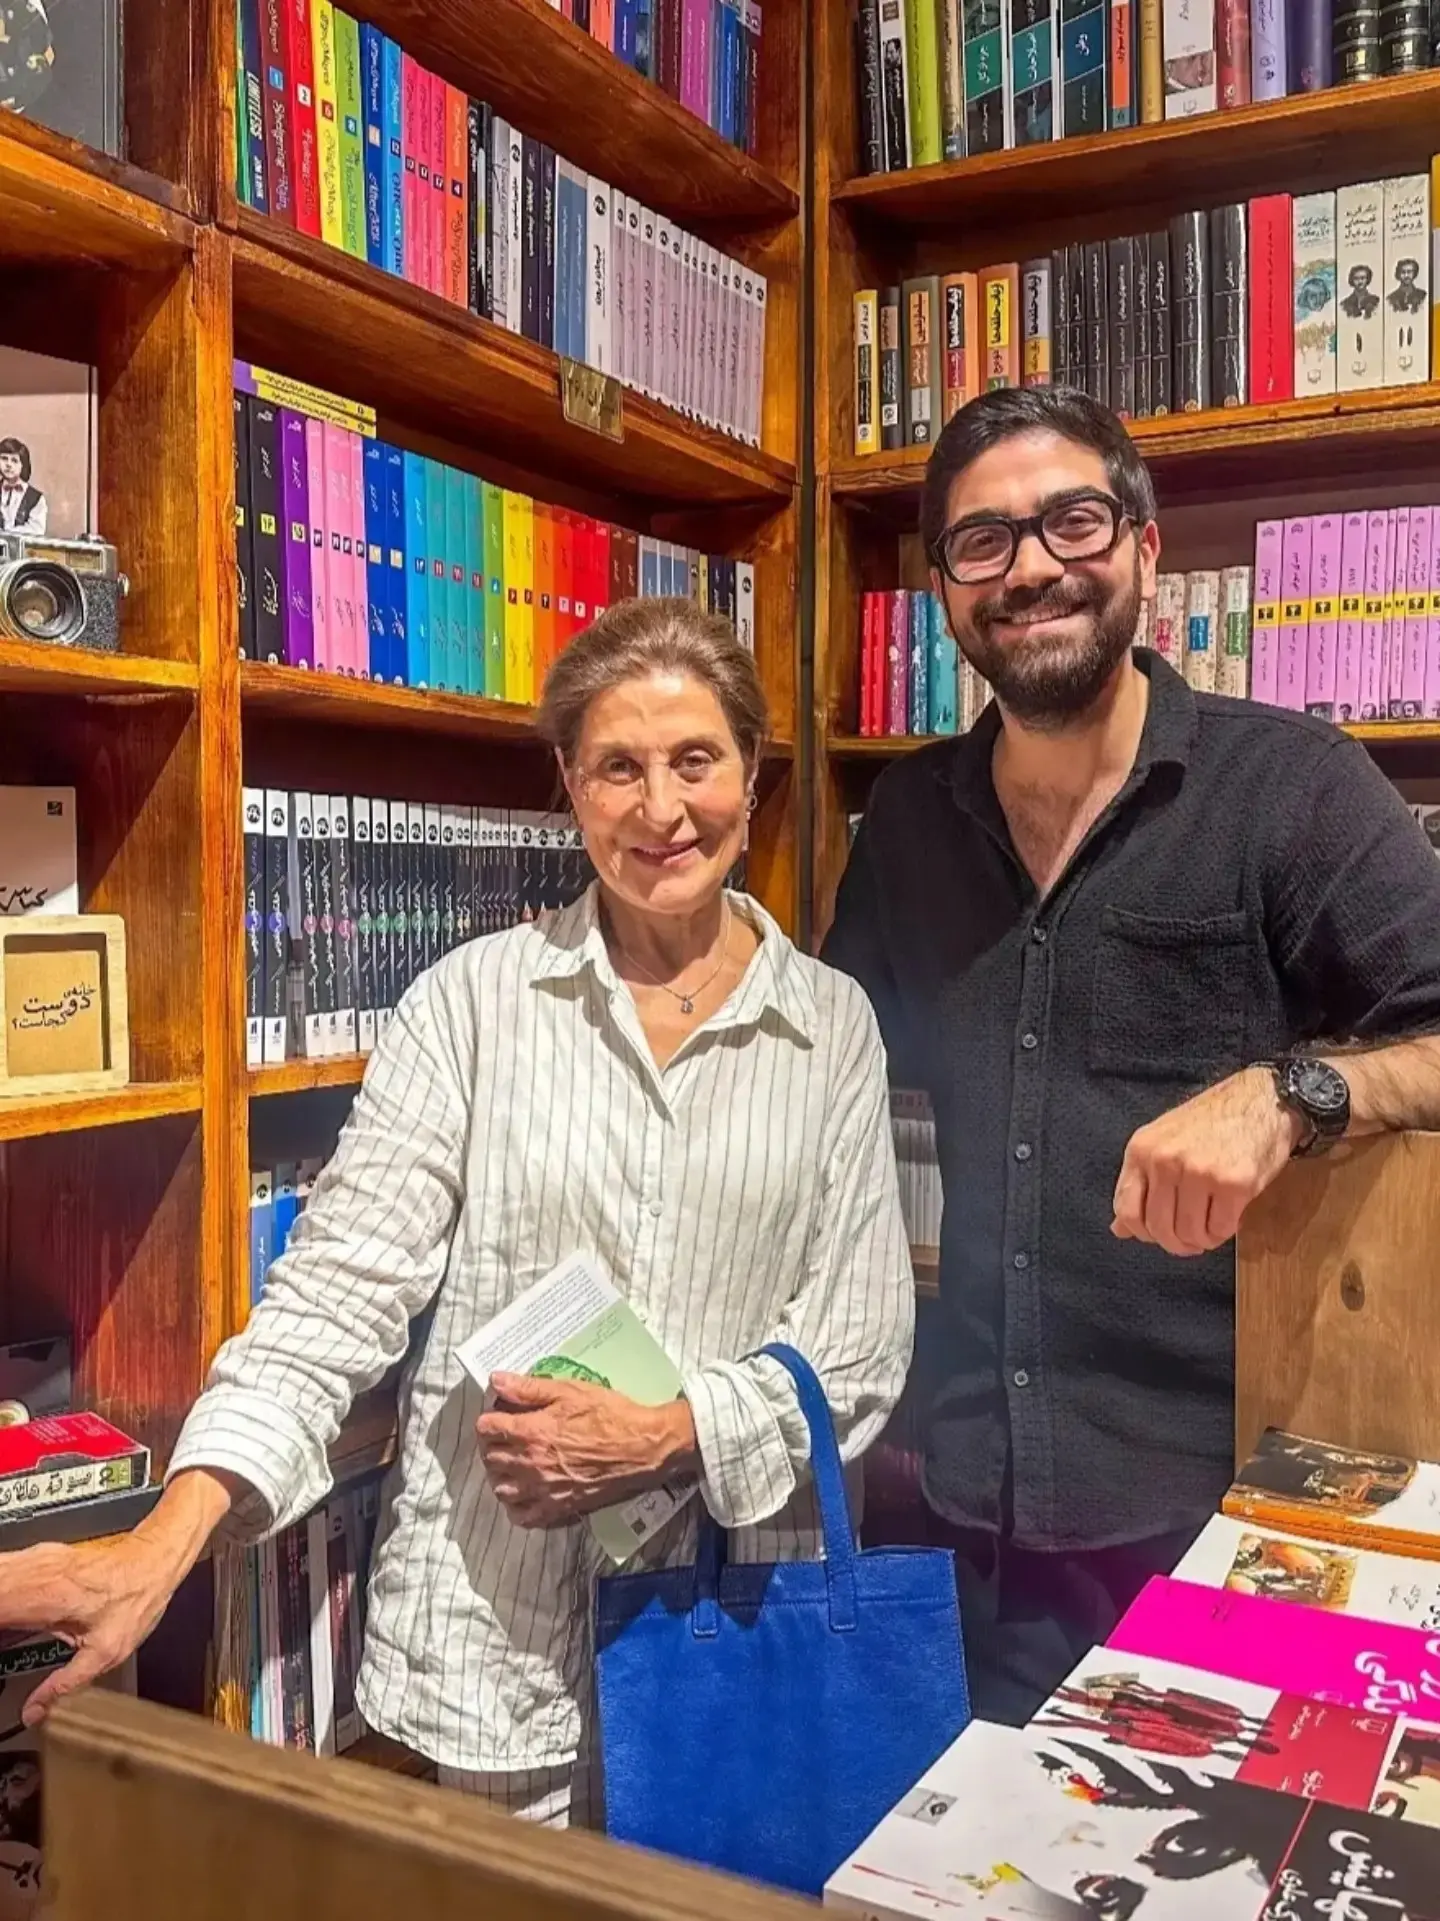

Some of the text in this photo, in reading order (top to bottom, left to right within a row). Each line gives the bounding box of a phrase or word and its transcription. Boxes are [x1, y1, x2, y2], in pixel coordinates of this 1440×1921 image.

[246, 71, 263, 141] LIMITLESS
[22, 996, 91, 1017] دوست
[12, 1010, 68, 1030] کجاست؟
